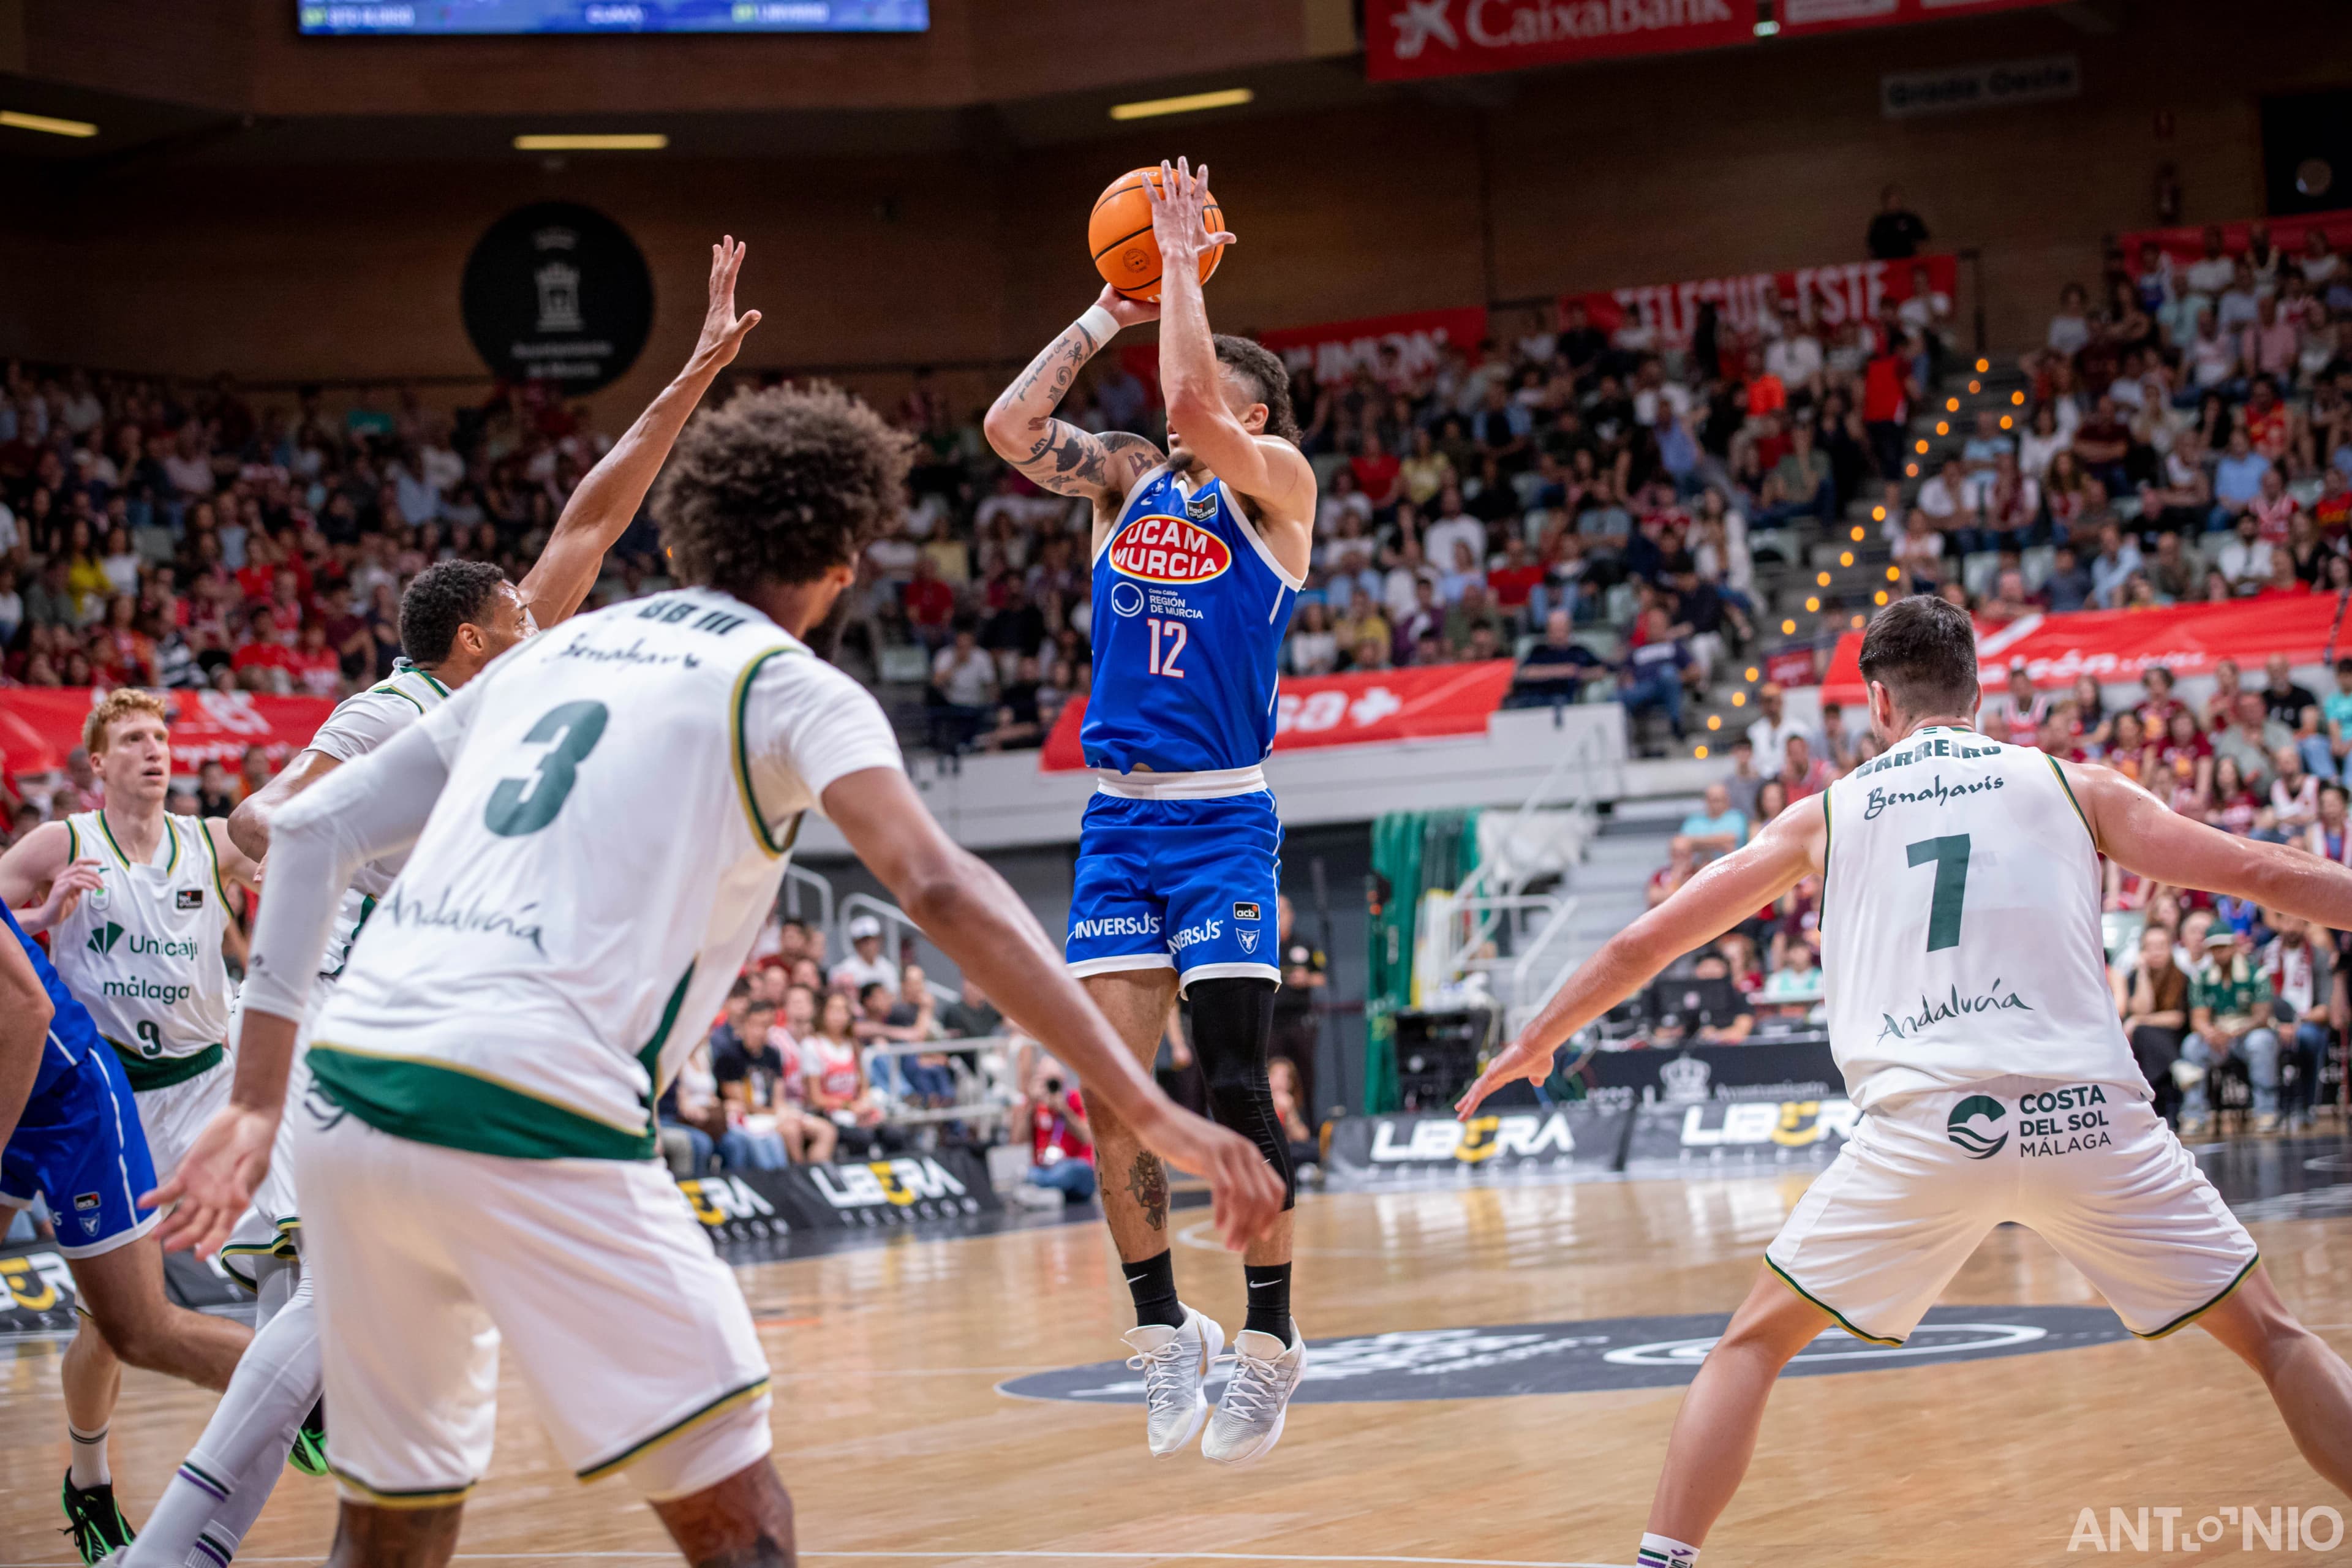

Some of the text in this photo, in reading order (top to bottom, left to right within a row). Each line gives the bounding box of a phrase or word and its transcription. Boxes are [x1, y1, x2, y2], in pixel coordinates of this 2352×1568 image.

[1126, 520, 1208, 555] UCAM
[1114, 547, 1218, 577] MURCIA
[1150, 595, 1186, 608] REGIÓN
[1150, 605, 1204, 619] DE MURCIA
[1147, 618, 1187, 678] 12
[484, 699, 609, 837] 3
[1905, 833, 1971, 952] 7
[1075, 912, 1160, 939] INVERSUS
[1237, 909, 1255, 918] acb
[137, 1020, 162, 1055] 9
[2019, 1084, 2106, 1114] COSTA
[1370, 1112, 1576, 1161] LIBERA
[2019, 1110, 2109, 1137] DEL SOL
[2020, 1131, 2113, 1158] MÁLAGA
